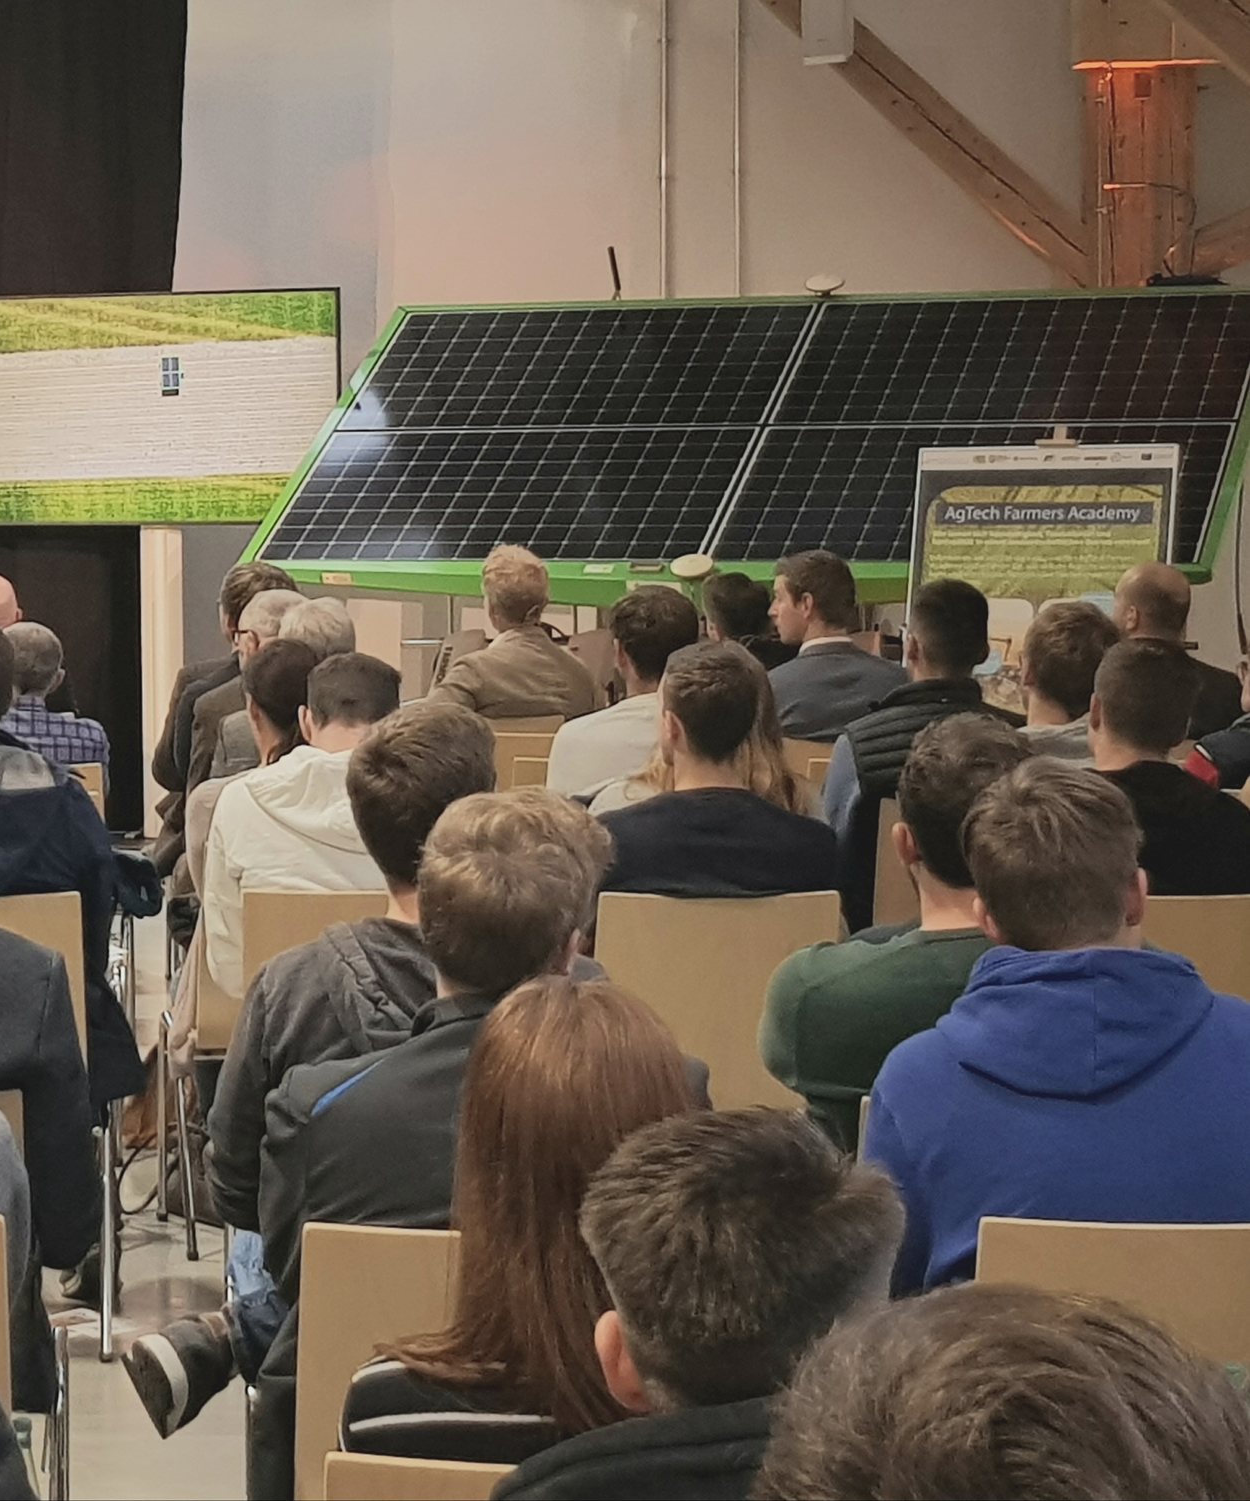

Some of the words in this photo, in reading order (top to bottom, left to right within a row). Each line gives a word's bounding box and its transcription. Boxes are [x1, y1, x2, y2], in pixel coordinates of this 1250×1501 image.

[944, 505, 1000, 523] AgTech
[1004, 505, 1064, 520] Farmers
[1068, 505, 1140, 523] Academy
